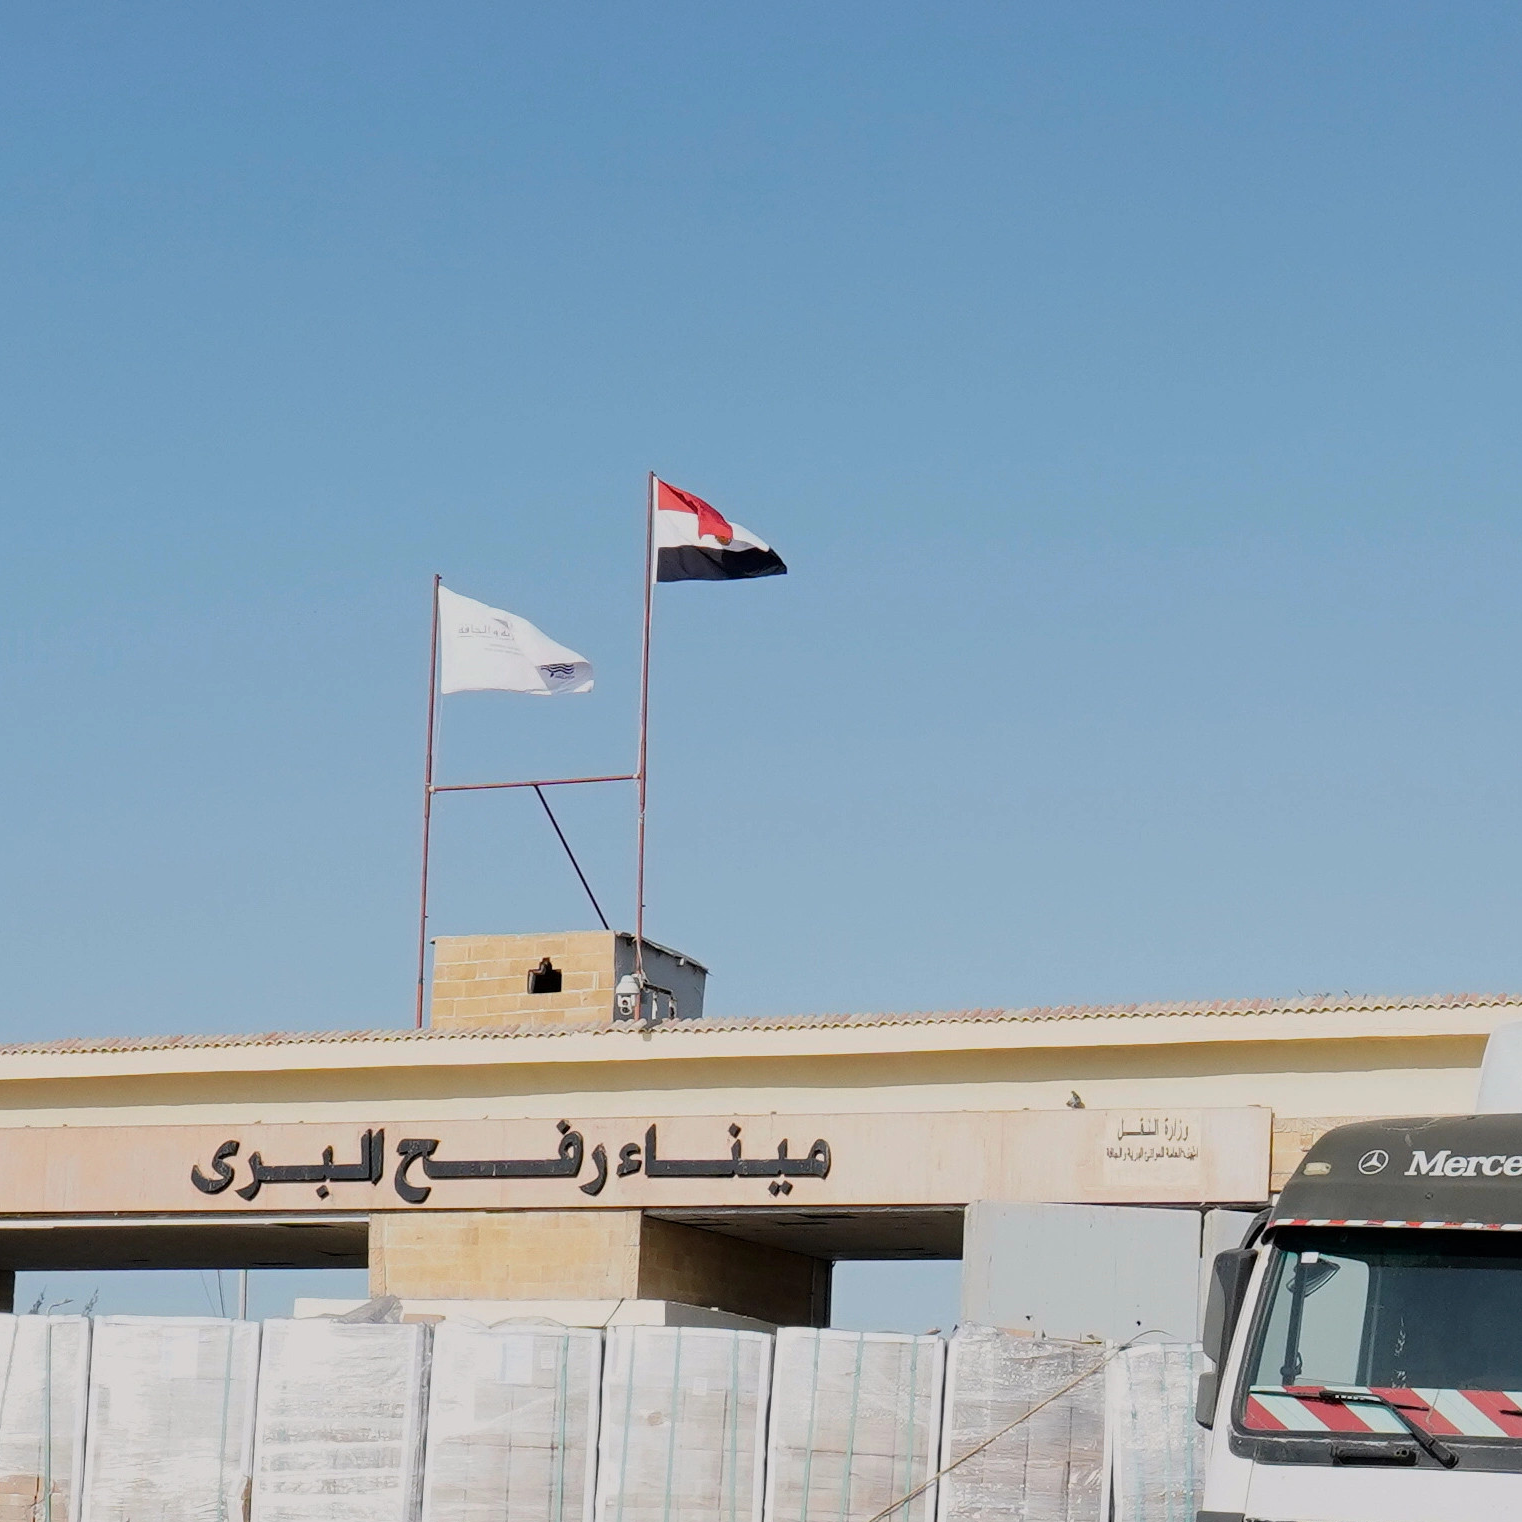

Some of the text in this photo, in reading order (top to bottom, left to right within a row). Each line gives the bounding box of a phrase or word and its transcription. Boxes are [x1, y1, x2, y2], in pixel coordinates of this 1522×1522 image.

[394, 1119, 608, 1205] رفح
[617, 1123, 831, 1197] ميناء
[1117, 1117, 1189, 1141] وزارة النقل
